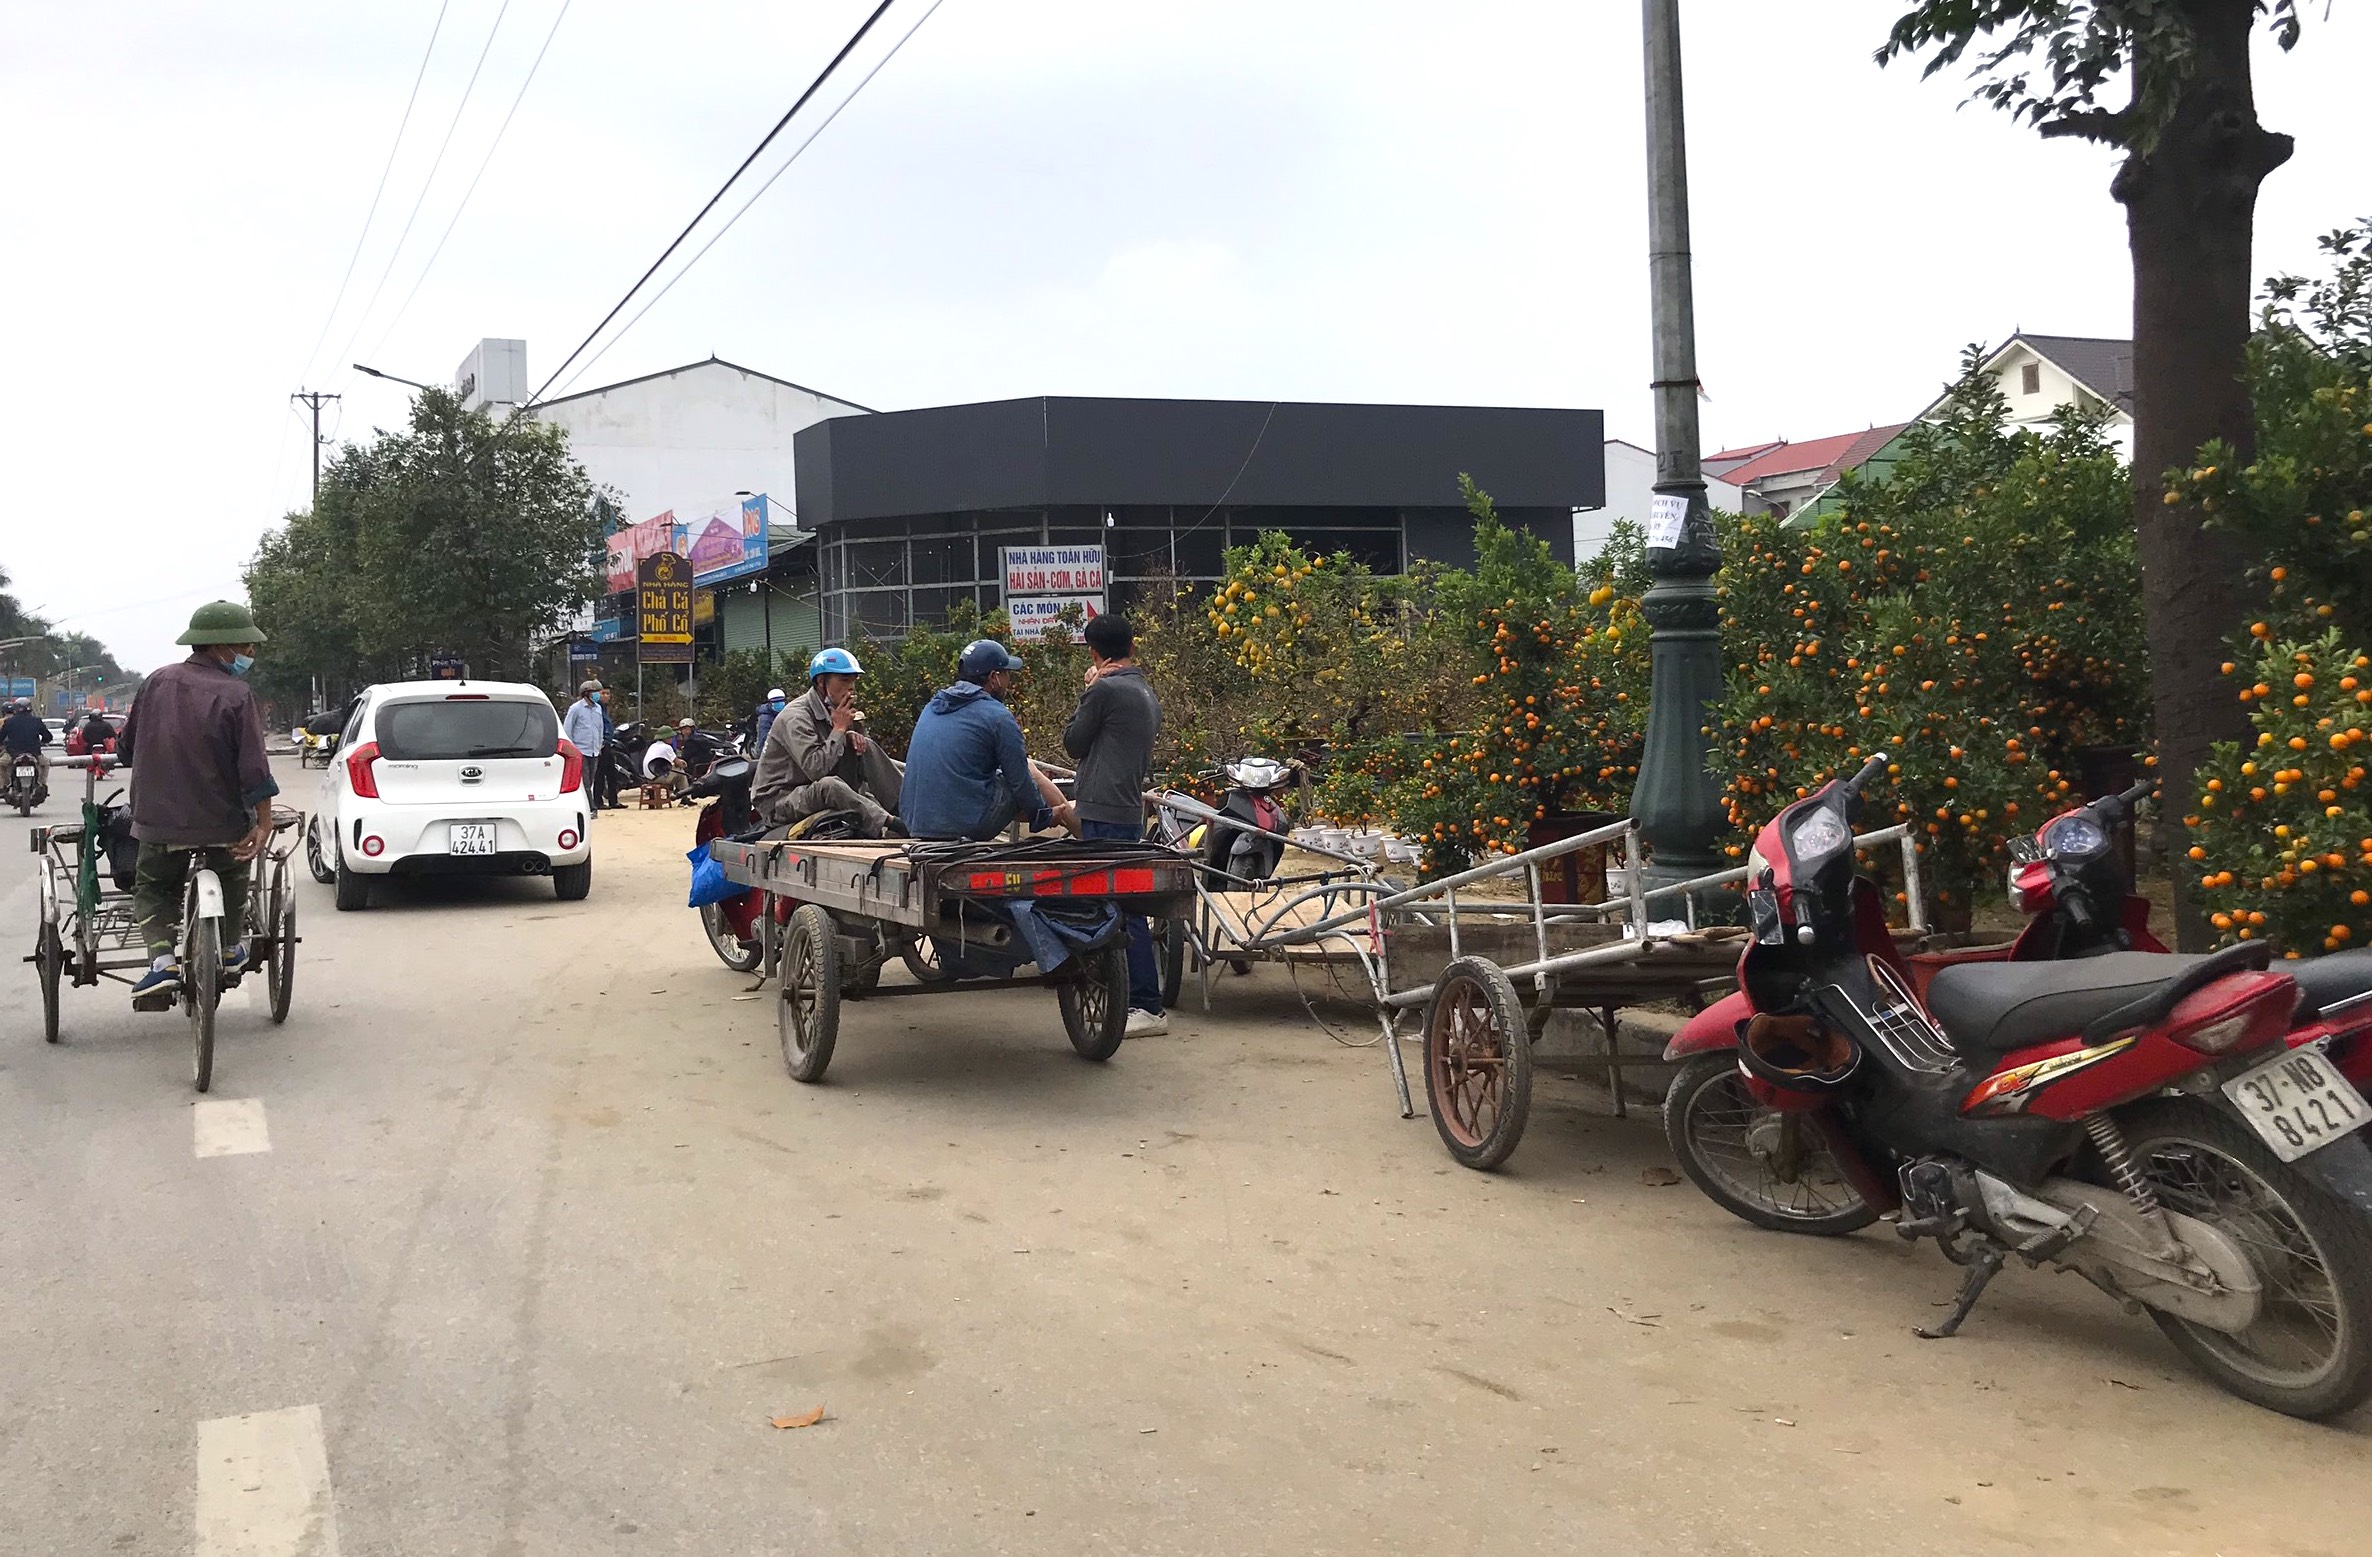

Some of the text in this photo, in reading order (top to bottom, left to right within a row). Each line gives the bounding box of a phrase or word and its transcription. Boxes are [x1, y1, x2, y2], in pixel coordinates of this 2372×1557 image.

[1009, 549, 1028, 565] NHÀ
[1030, 549, 1055, 565] HÀNG
[1057, 548, 1080, 564] TOÀN
[1009, 566, 1024, 589] HẢI
[1027, 566, 1046, 589] SẢN
[1075, 566, 1088, 588] GÀ
[1089, 567, 1101, 588] CÁ
[643, 589, 666, 609] Chả
[673, 591, 688, 609] Cá
[1013, 602, 1033, 615] CÁC
[1036, 601, 1060, 614] MÓN
[643, 610, 690, 632] Phố Cổ
[463, 768, 481, 776] KIA
[461, 826, 485, 839] 37A
[452, 840, 493, 854] 424.41
[2272, 1089, 2356, 1147] 8421
